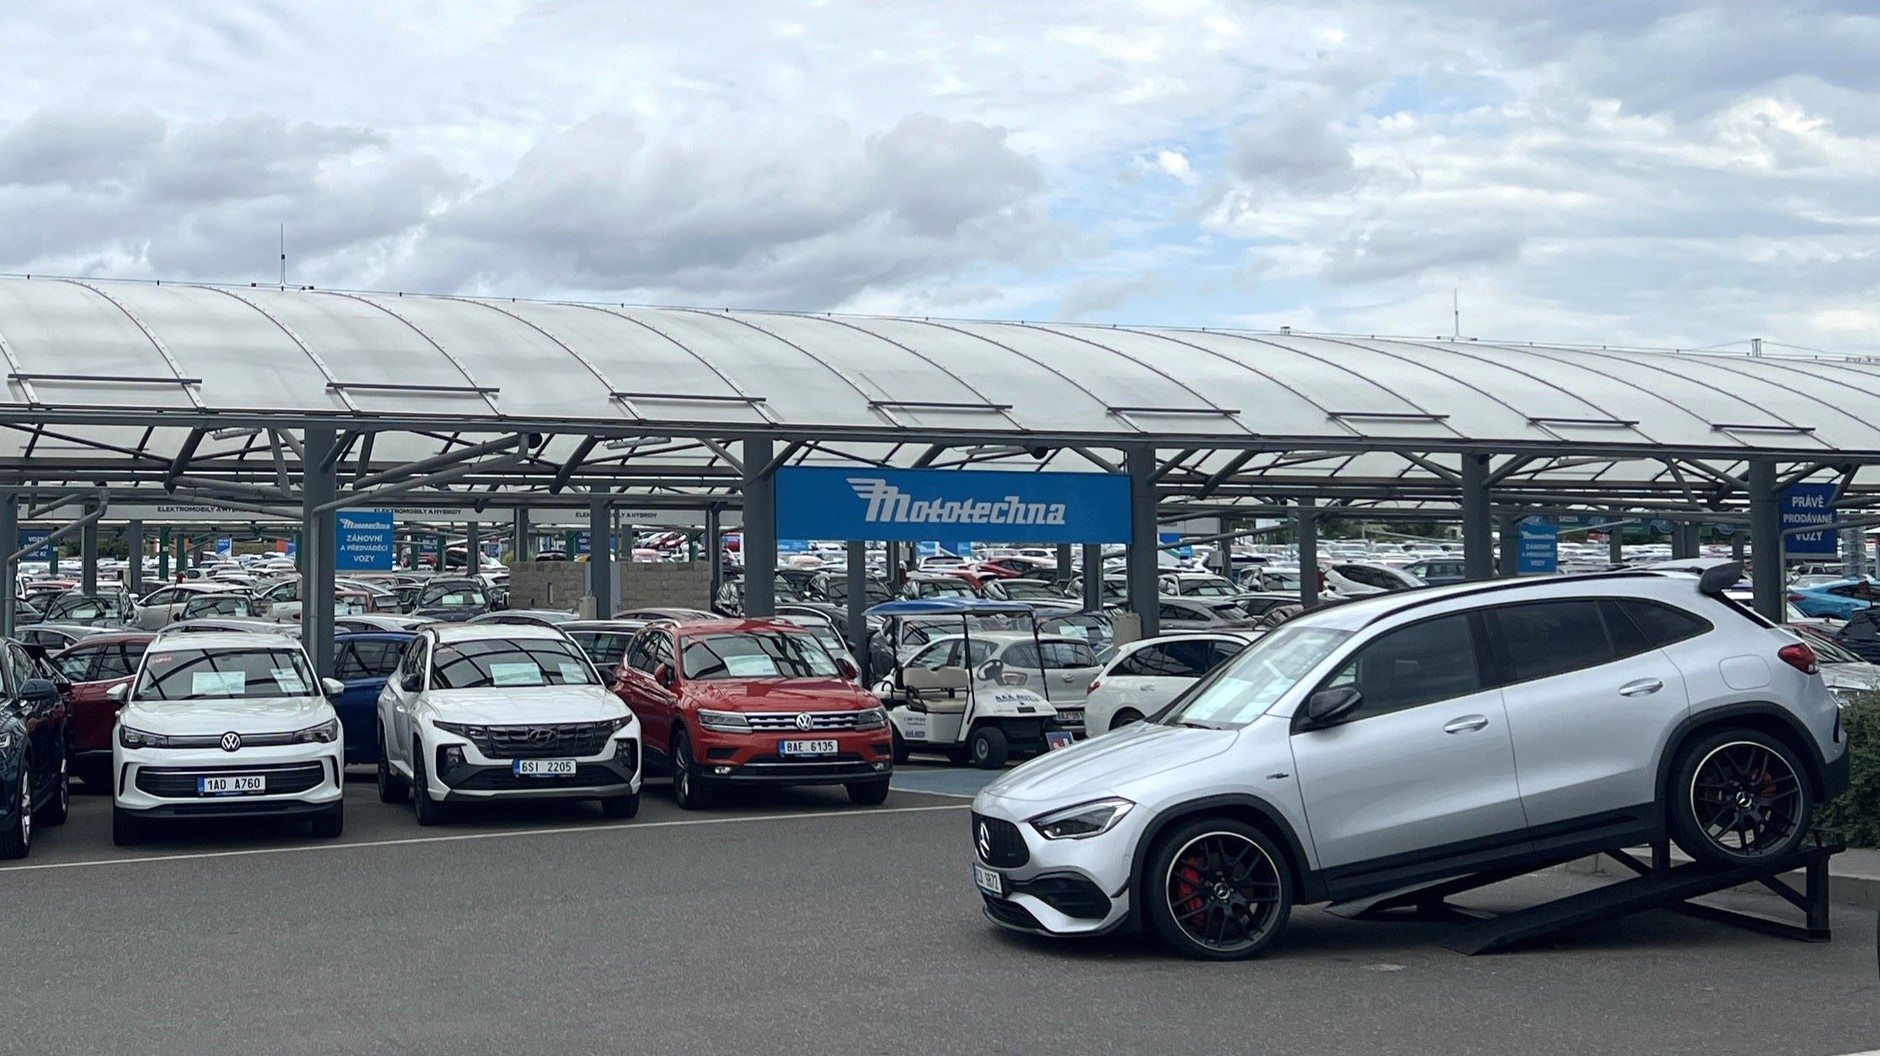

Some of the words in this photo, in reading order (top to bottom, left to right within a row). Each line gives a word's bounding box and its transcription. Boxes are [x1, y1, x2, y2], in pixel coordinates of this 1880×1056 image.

[846, 477, 1066, 525] Mototechna
[1792, 494, 1825, 508] PRÁVĚ
[1783, 512, 1833, 524] PRODÁVANÉ
[346, 534, 383, 542] ZÁNOVNÍ
[787, 742, 803, 752] 8AE
[810, 741, 833, 751] 6135
[522, 762, 538, 772] 6SI
[547, 761, 571, 772] 2205
[208, 779, 226, 790] 1AD
[234, 778, 260, 789] A760
